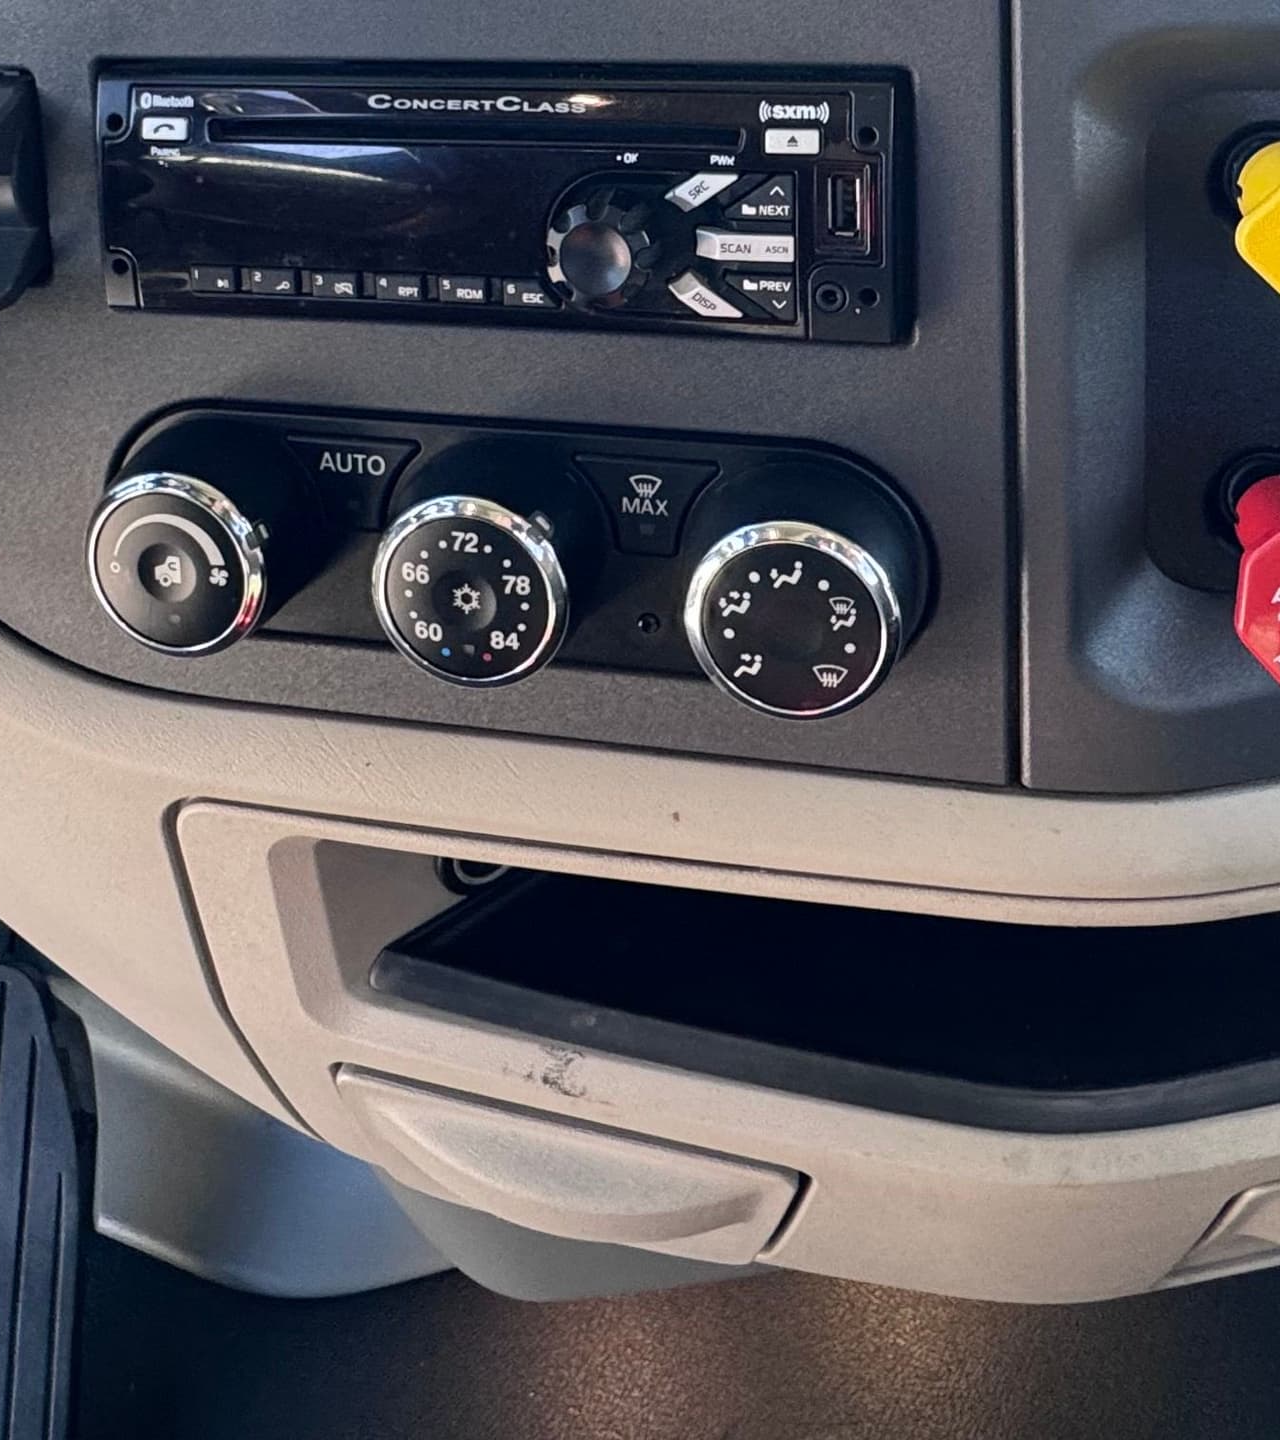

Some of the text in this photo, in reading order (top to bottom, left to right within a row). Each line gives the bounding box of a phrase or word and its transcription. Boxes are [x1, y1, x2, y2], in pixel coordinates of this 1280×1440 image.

[688, 180, 710, 200] SRC
[759, 205, 790, 216] NEXT
[720, 243, 751, 254] SCAN
[254, 271, 262, 282] 2
[315, 274, 324, 285] 3
[759, 280, 791, 292] PREV
[379, 278, 419, 298] 4 RPT
[442, 279, 484, 300] 5 RDM
[506, 284, 544, 304] 6 ESC
[691, 292, 717, 311] DISP
[320, 451, 386, 477] AUTO
[621, 496, 669, 516] MAX
[451, 531, 480, 553] 72
[401, 562, 431, 585] 66
[502, 575, 532, 596] 78
[414, 621, 443, 642] 60
[490, 630, 521, 650] 84
